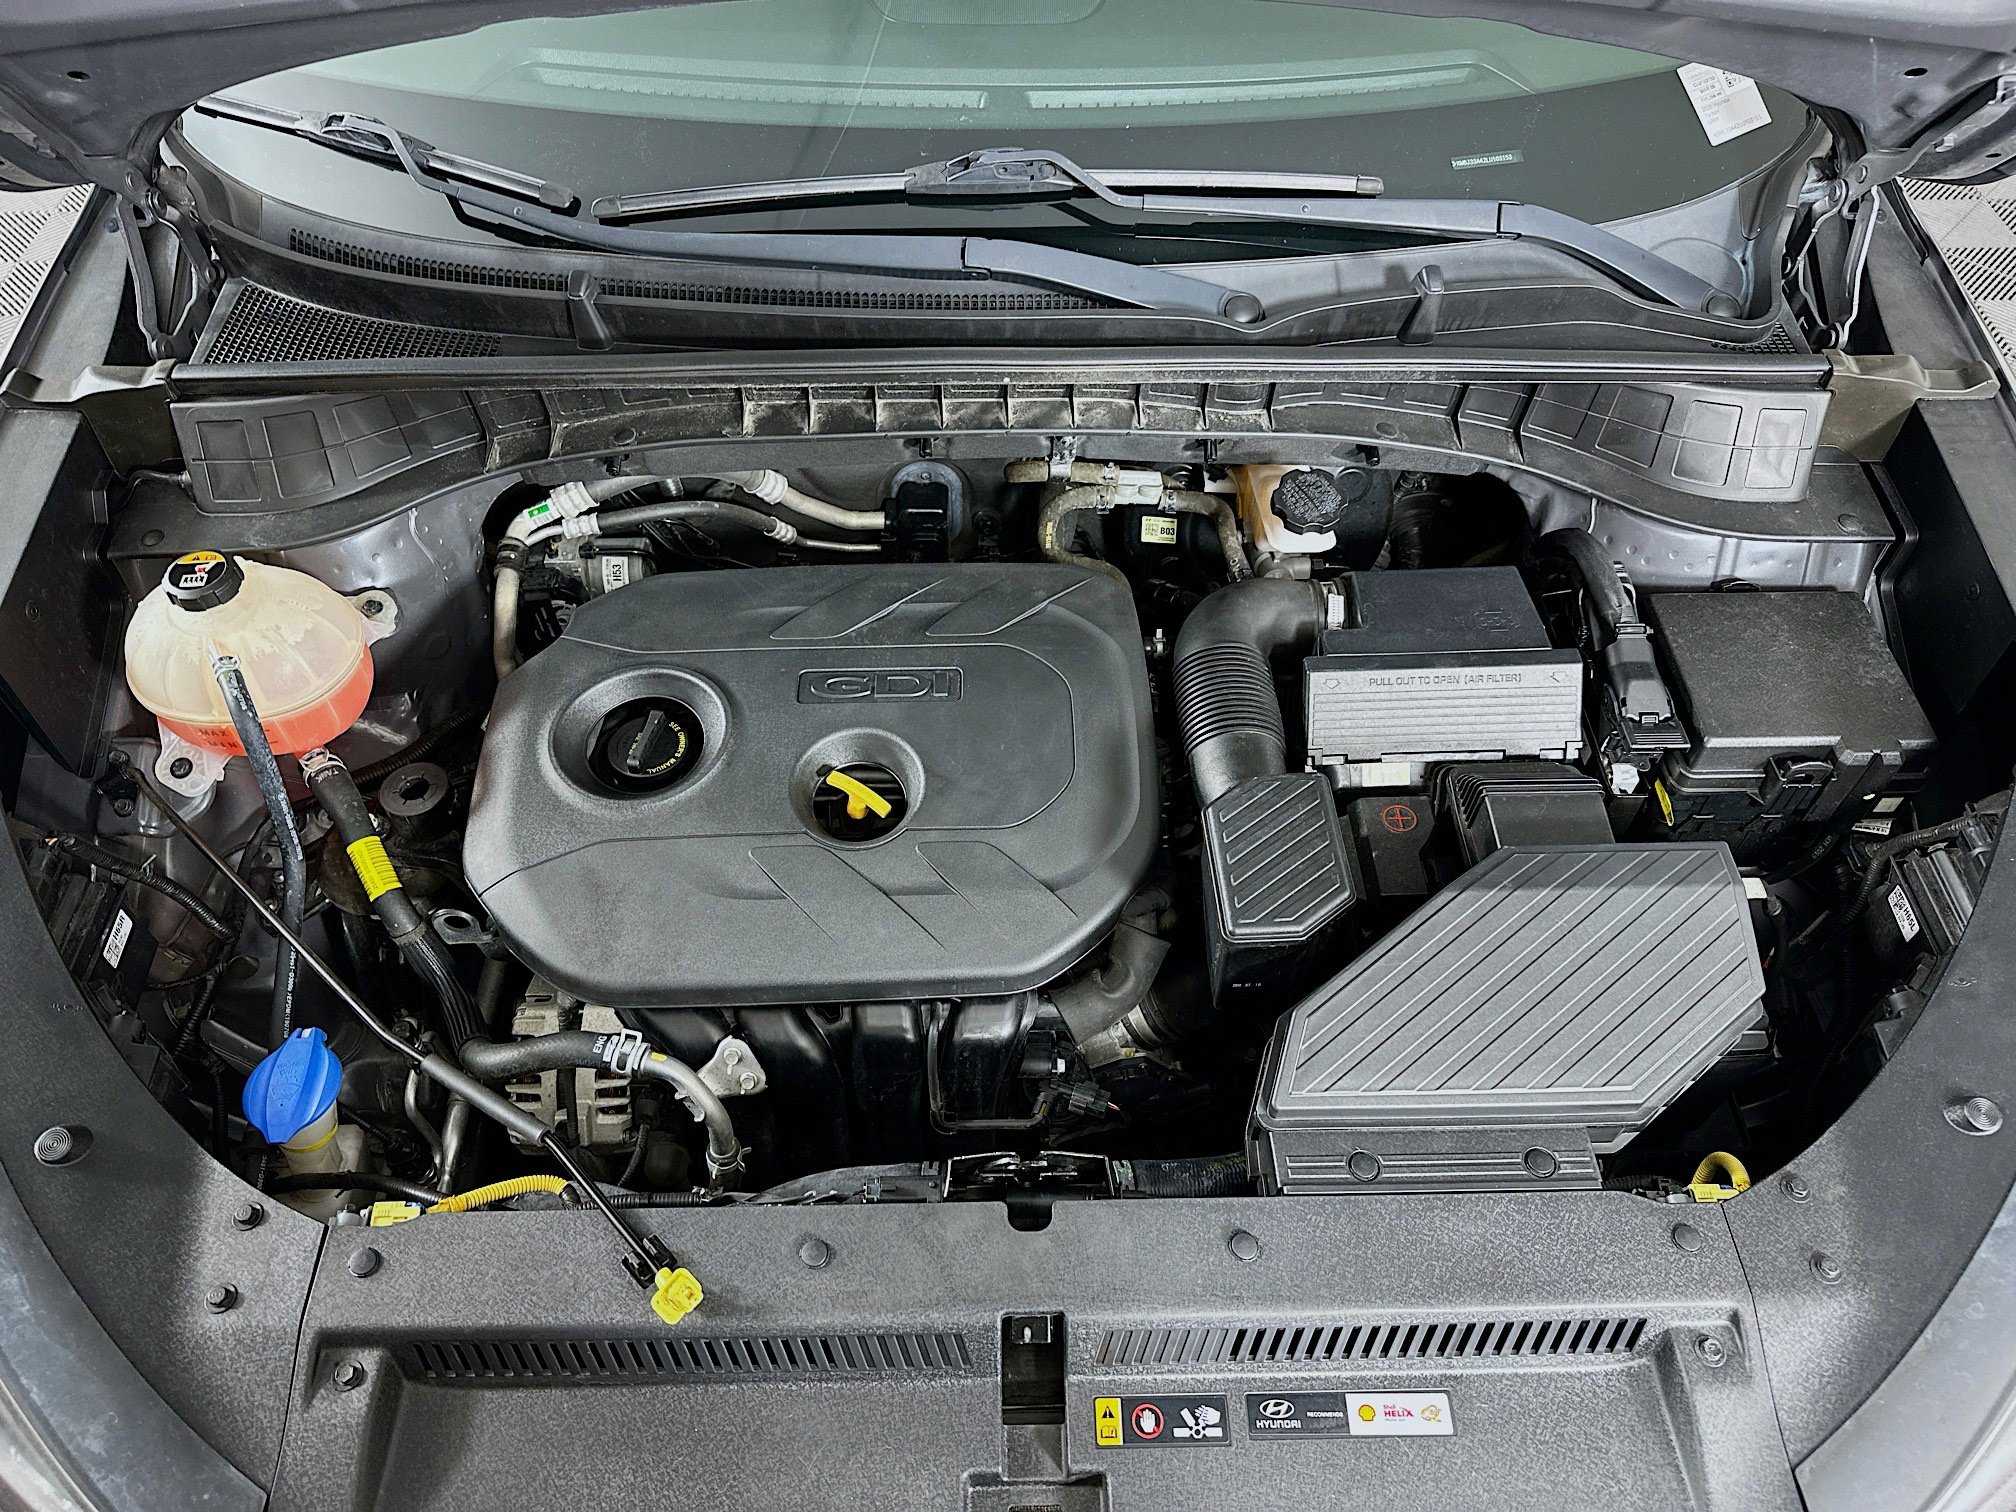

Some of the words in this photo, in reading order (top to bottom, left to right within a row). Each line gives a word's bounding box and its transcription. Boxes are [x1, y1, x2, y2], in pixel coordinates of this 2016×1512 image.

[1160, 527, 1175, 536] B03
[612, 564, 622, 582] H53
[810, 672, 949, 698] GDI
[1369, 677, 1394, 686] PULL
[1395, 676, 1416, 686] OUT
[1418, 675, 1431, 685] TO
[1433, 674, 1460, 684] OPEN
[199, 728, 229, 737] MAX
[668, 721, 681, 732] SEE
[646, 757, 677, 774] MANUAL
[1903, 907, 1916, 932] H65L
[592, 1035, 608, 1054] ENG
[1384, 1408, 1414, 1417] HELIX
[1256, 1419, 1302, 1429] HYUNDAI
